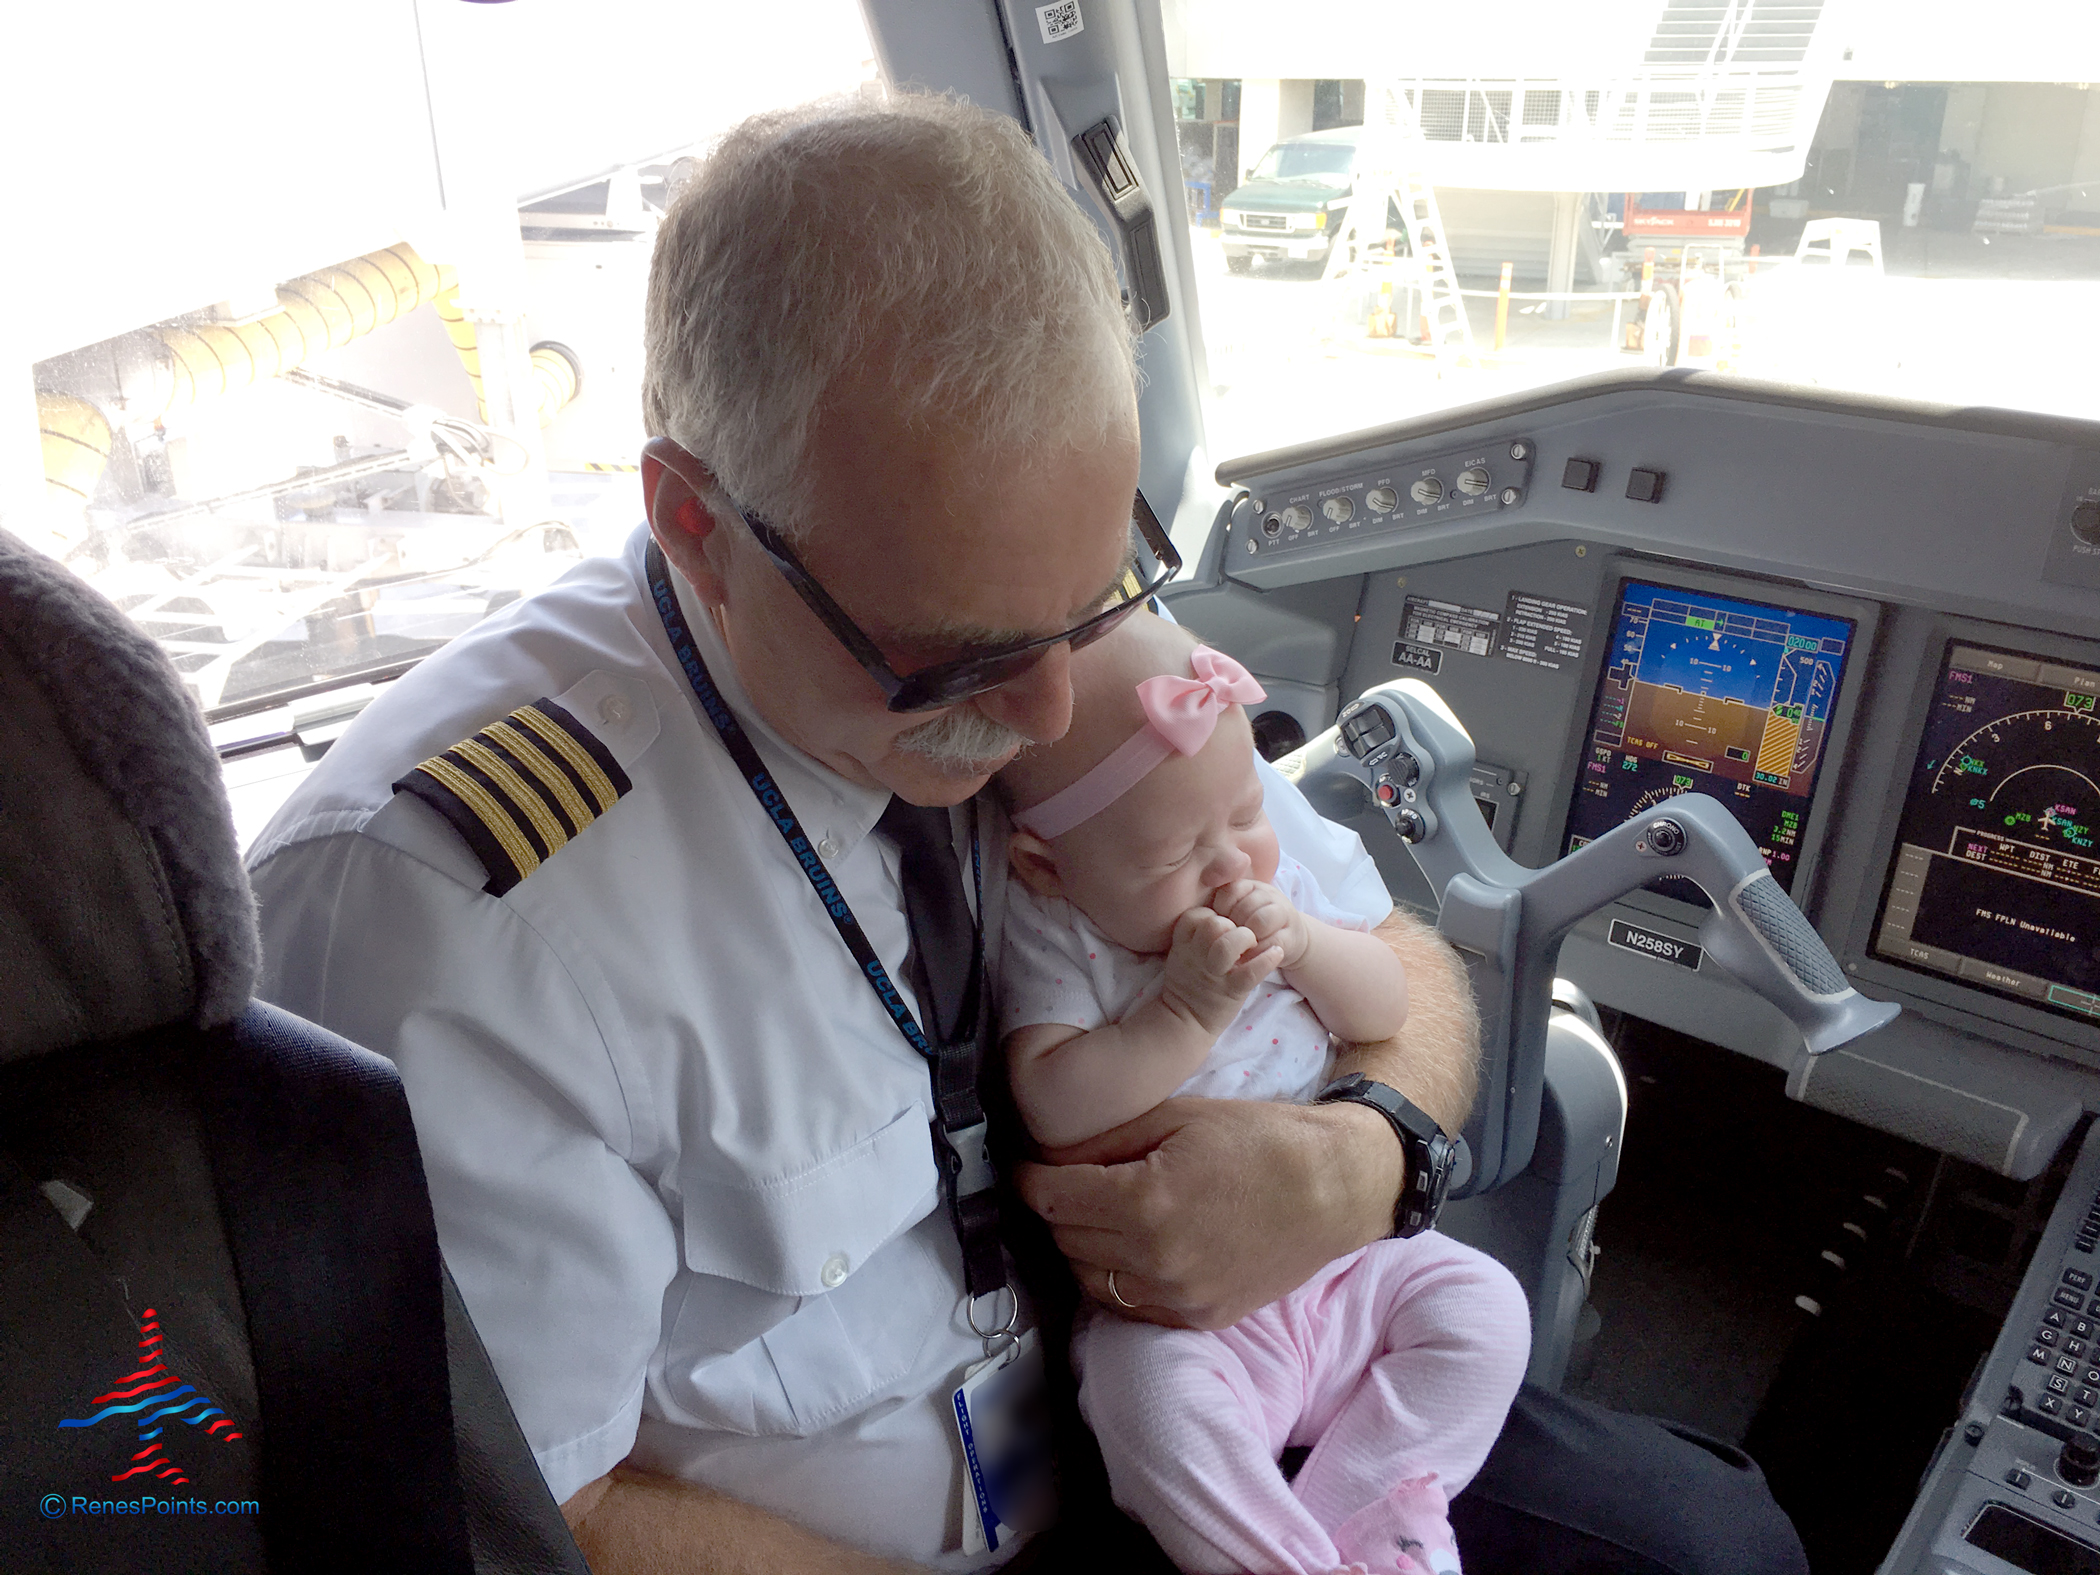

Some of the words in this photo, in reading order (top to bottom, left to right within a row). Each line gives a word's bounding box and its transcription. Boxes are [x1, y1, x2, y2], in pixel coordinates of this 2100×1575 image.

[1464, 458, 1486, 468] EICAS
[1422, 468, 1436, 477] MFD
[1377, 478, 1391, 486] PFD
[1289, 494, 1310, 504] CHART
[1484, 494, 1497, 502] BRT
[1437, 504, 1450, 512] BRT
[1372, 516, 1383, 524] DIM
[1392, 512, 1404, 521] BRT
[2073, 545, 2092, 554] PUSH
[1518, 596, 1541, 606] LANDING
[1542, 601, 1556, 609] GEAR
[1630, 616, 1638, 624] 70
[1527, 621, 1554, 632] EXTENDED
[653, 578, 682, 644] UCLA
[678, 644, 730, 730] BRUINS
[1406, 645, 1430, 657] SELCAL
[1398, 652, 1432, 668] AA-AA
[1690, 658, 1699, 666] 10
[1800, 656, 1814, 665] 500
[1722, 664, 1732, 672] 10
[1987, 660, 2004, 670] Map
[2074, 676, 2096, 688] Plan
[1949, 670, 1973, 684] FMS1
[2066, 693, 2094, 710] 073
[1675, 719, 1684, 727] 10
[2044, 720, 2052, 730] 6
[1708, 726, 1717, 734] 10
[1627, 736, 1643, 746] TCAS
[1646, 741, 1658, 750] OFF
[1992, 733, 2000, 744] 3
[1587, 762, 1606, 774] FMS1
[1622, 761, 1638, 772] 272
[1676, 776, 1691, 786] 073
[1755, 771, 1778, 783] 30.02
[1778, 777, 1788, 786] IN
[1737, 782, 1751, 792] DTK
[752, 772, 794, 834] UCLA
[2054, 804, 2077, 816] KSAN
[2016, 812, 2032, 822] MZB
[1652, 820, 1680, 835] CHRONO
[1784, 820, 1798, 830] MZB
[1976, 830, 2005, 842] PROGRESS
[2071, 836, 2094, 848] KNZY
[1966, 842, 1988, 854] NEXT
[1772, 850, 1790, 861] 1.00
[1966, 850, 1987, 862] DEST
[2000, 843, 2016, 854] WPT
[2029, 850, 2050, 862] DIST
[2062, 858, 2080, 870] ETE
[1976, 908, 1991, 920] FMS
[1995, 912, 2016, 926] FPLN
[2020, 920, 2076, 942] Unavailable
[1626, 930, 1684, 959] N258SY
[1910, 948, 1930, 960] TCAS
[1986, 970, 2021, 988] Weather
[866, 960, 906, 1019] UCLA
[2050, 1312, 2060, 1322] A
[2077, 1322, 2086, 1332] B
[2042, 1330, 2052, 1340] G
[2069, 1340, 2080, 1352] H
[2032, 1348, 2045, 1360] M
[2060, 1360, 2072, 1370] N
[2088, 1370, 2100, 1381] O
[2054, 1380, 2063, 1388] S
[2083, 1390, 2091, 1400] T
[2045, 1397, 2056, 1408] X
[2075, 1408, 2084, 1419] Y
[956, 1392, 970, 1436] FLIGHT
[967, 1442, 988, 1514] OPERATIONS
